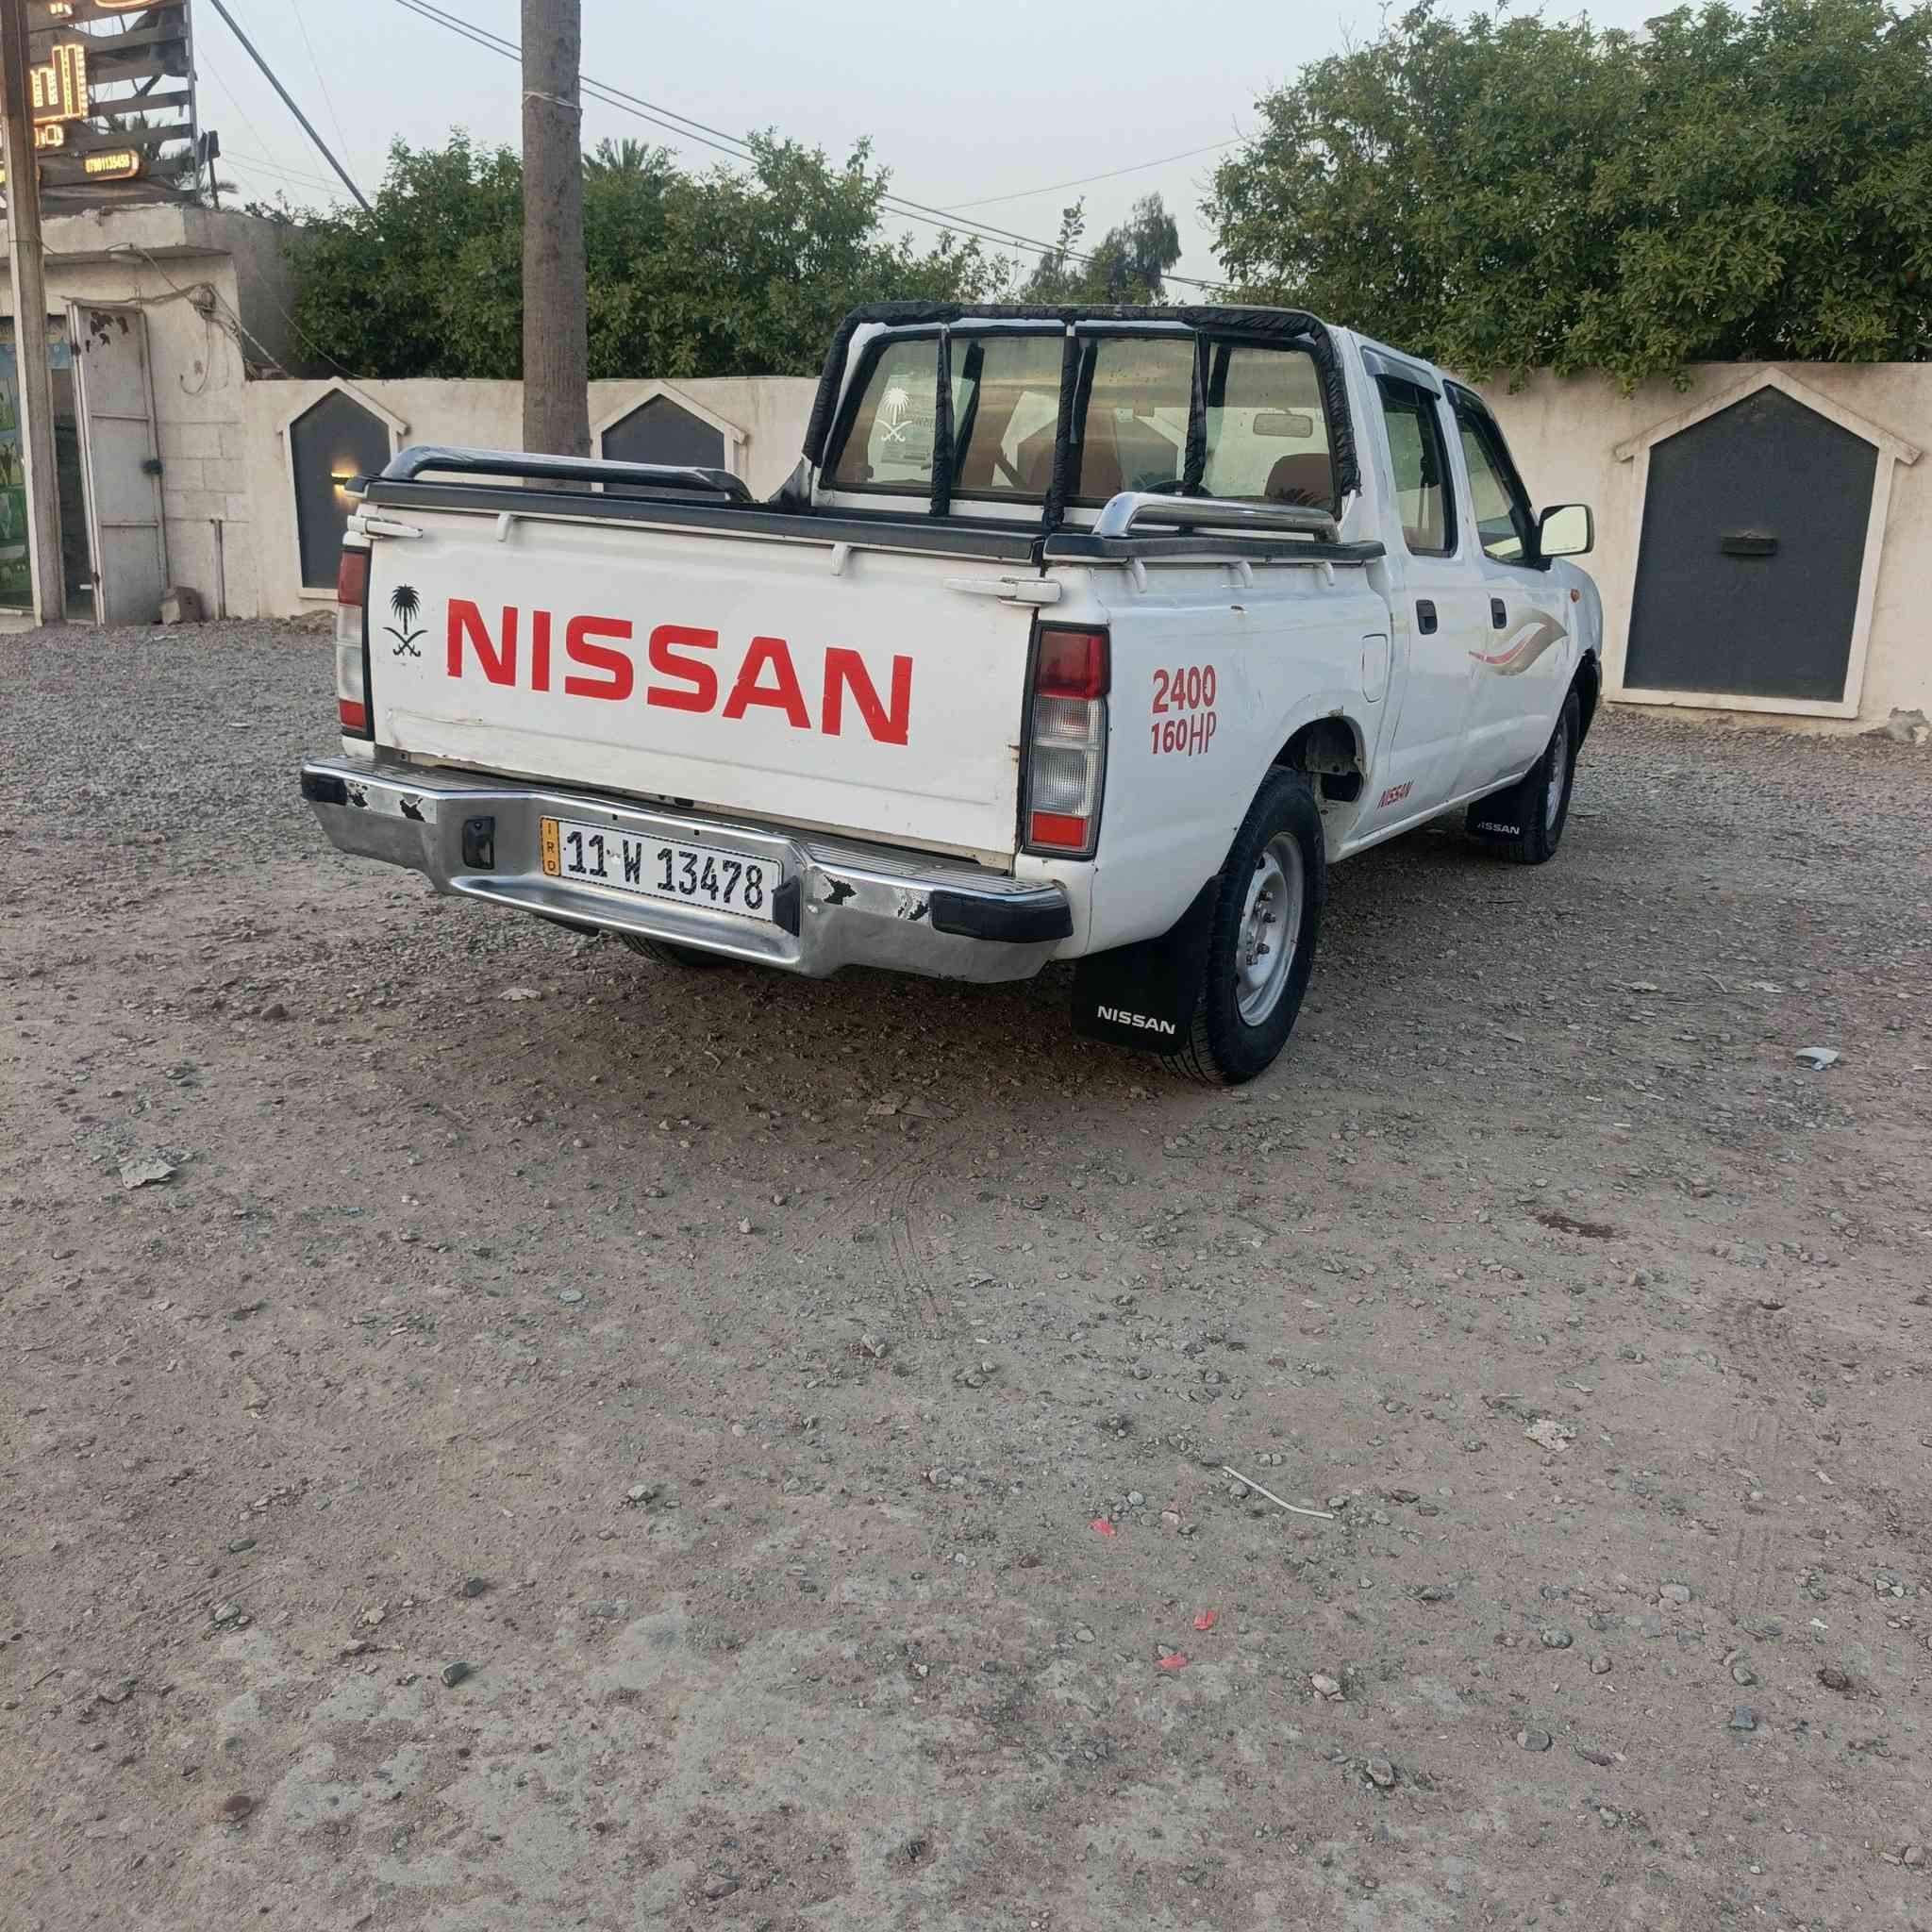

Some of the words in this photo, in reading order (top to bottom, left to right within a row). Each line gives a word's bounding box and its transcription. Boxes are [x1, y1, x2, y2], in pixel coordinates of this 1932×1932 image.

[447, 598, 913, 746] NISSAN
[1152, 664, 1217, 714] 2400
[1151, 711, 1217, 757] 160HP
[566, 830, 608, 878] 11
[622, 839, 642, 885] W
[657, 847, 763, 910] 13478
[1096, 1005, 1176, 1035] NISSAN
